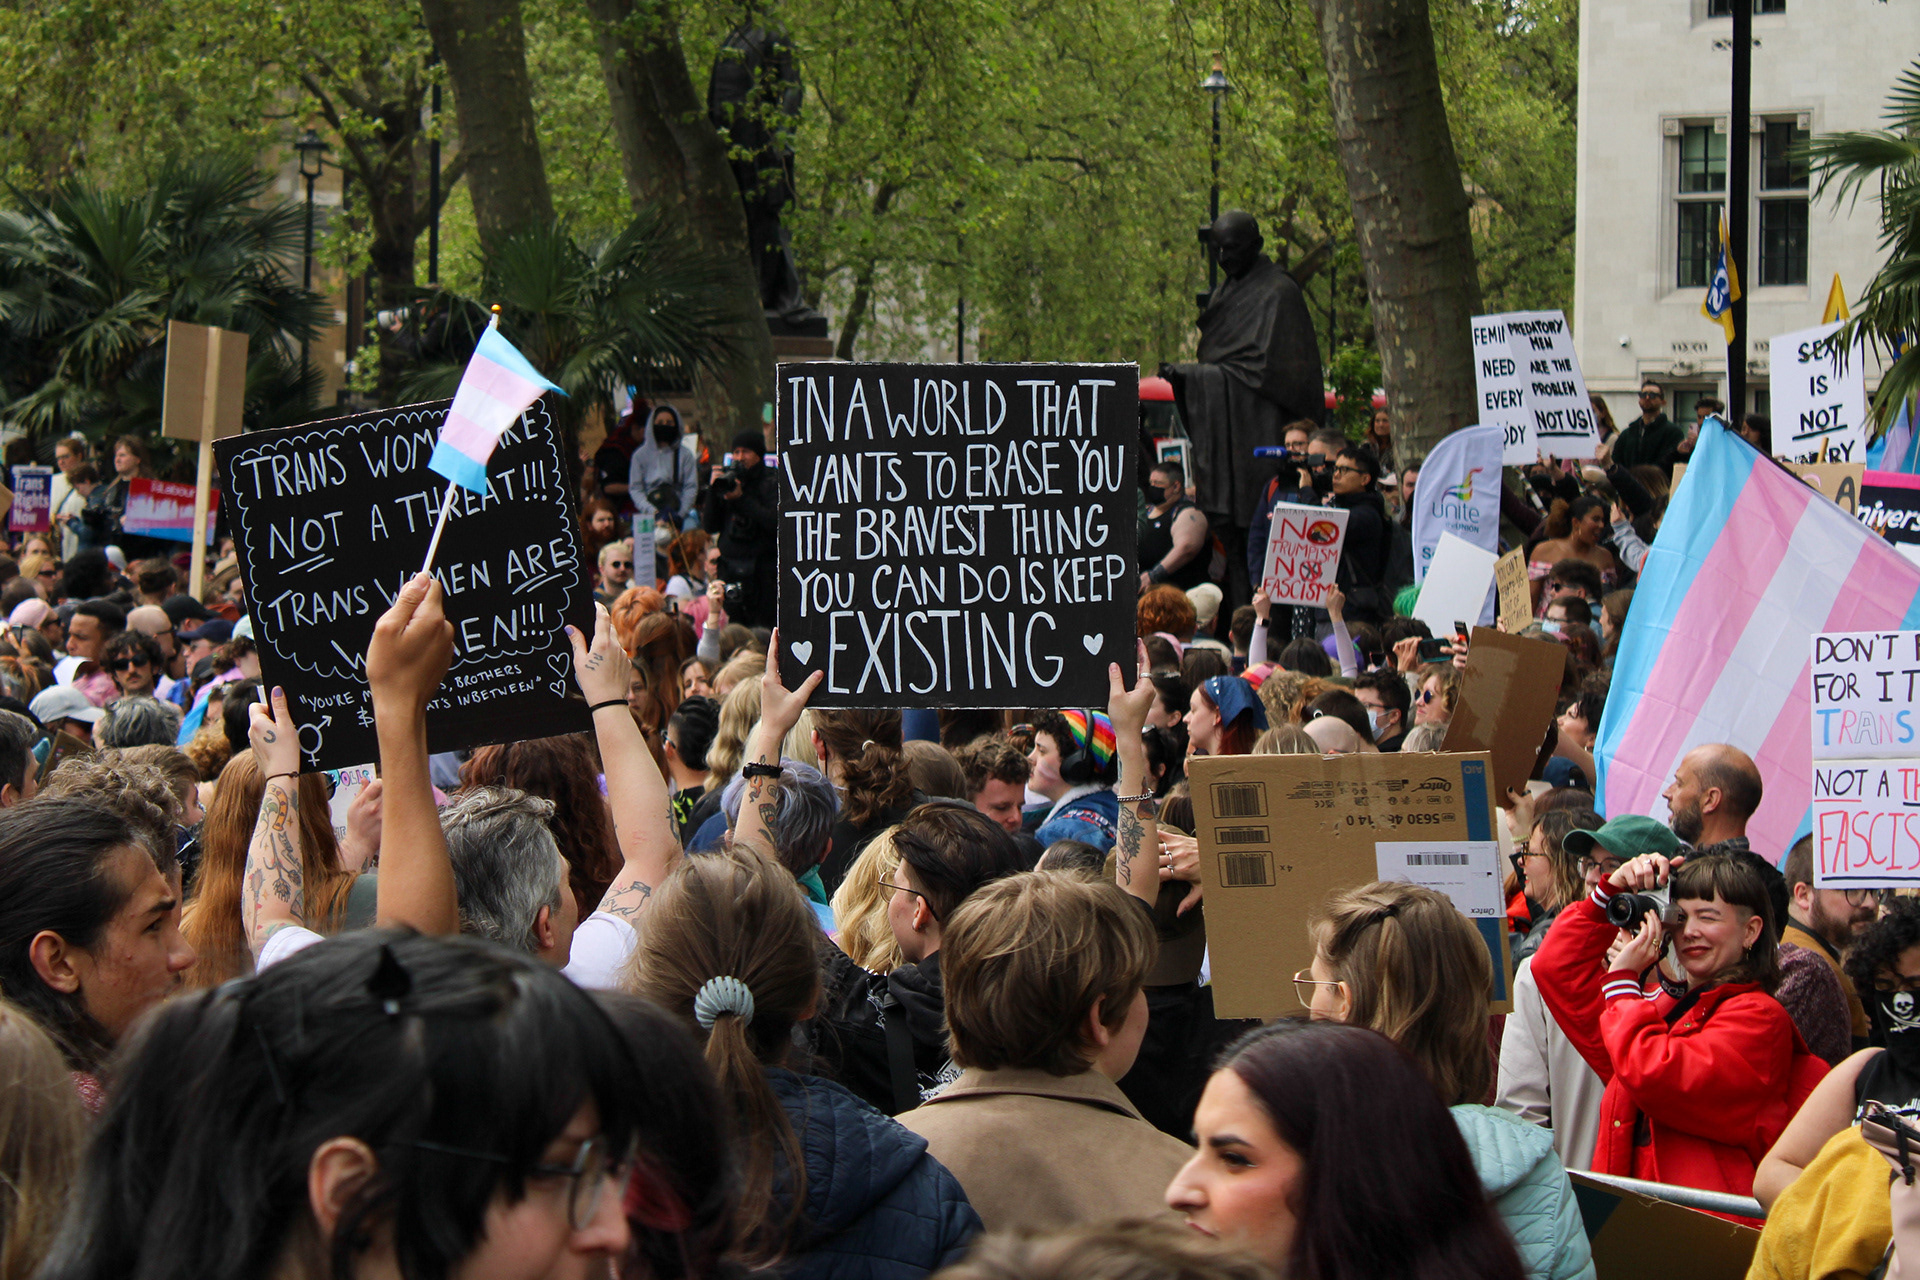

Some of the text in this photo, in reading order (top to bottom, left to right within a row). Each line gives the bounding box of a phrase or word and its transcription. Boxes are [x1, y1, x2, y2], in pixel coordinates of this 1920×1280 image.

[1507, 319, 1563, 336] PREDATORY
[1529, 337, 1553, 351] MEN
[1482, 358, 1516, 378] NEED
[1530, 358, 1572, 375] ARE THE
[1531, 381, 1577, 397] PROBLEM
[1810, 375, 1828, 396] IS
[788, 376, 1116, 445] IN A WORLD THAT
[1485, 389, 1523, 410] EVERY
[1534, 408, 1595, 434] NOT US!
[1800, 404, 1843, 432] NOT
[240, 444, 346, 499] TRANS
[360, 427, 441, 478] WOM
[782, 439, 1124, 504] WANTS TO ERASE YOU
[14, 474, 44, 491] Trans
[14, 491, 49, 512] Rights
[270, 460, 547, 559] NOT A THREAT!!!
[13, 509, 37, 526] Now
[1858, 500, 1920, 531] nivers
[785, 504, 1109, 561] THE BRAVEST THING
[1271, 540, 1338, 565] TRUMPISM
[268, 538, 573, 631] TRANS WMEN ARE
[791, 554, 1126, 617] YOU CAN DO IS KEEP
[1263, 577, 1332, 603] FASCISM
[331, 603, 544, 670] WEN!!!
[1816, 634, 1899, 664] DON'T
[828, 610, 1064, 694] EXISTING
[455, 664, 522, 687] BROTHERS
[1814, 669, 1920, 703] FOR IT
[426, 699, 451, 711] AT'S
[1816, 708, 1914, 746] TRANS
[1416, 780, 1452, 792] Ontex
[1814, 769, 1868, 797] NOT
[1877, 769, 1889, 797] A
[1346, 815, 1355, 826] 0
[1358, 815, 1374, 826] 14
[1407, 814, 1440, 825] 5630
[1819, 810, 1920, 874] FASCIS
[1471, 907, 1496, 916] Ontex
